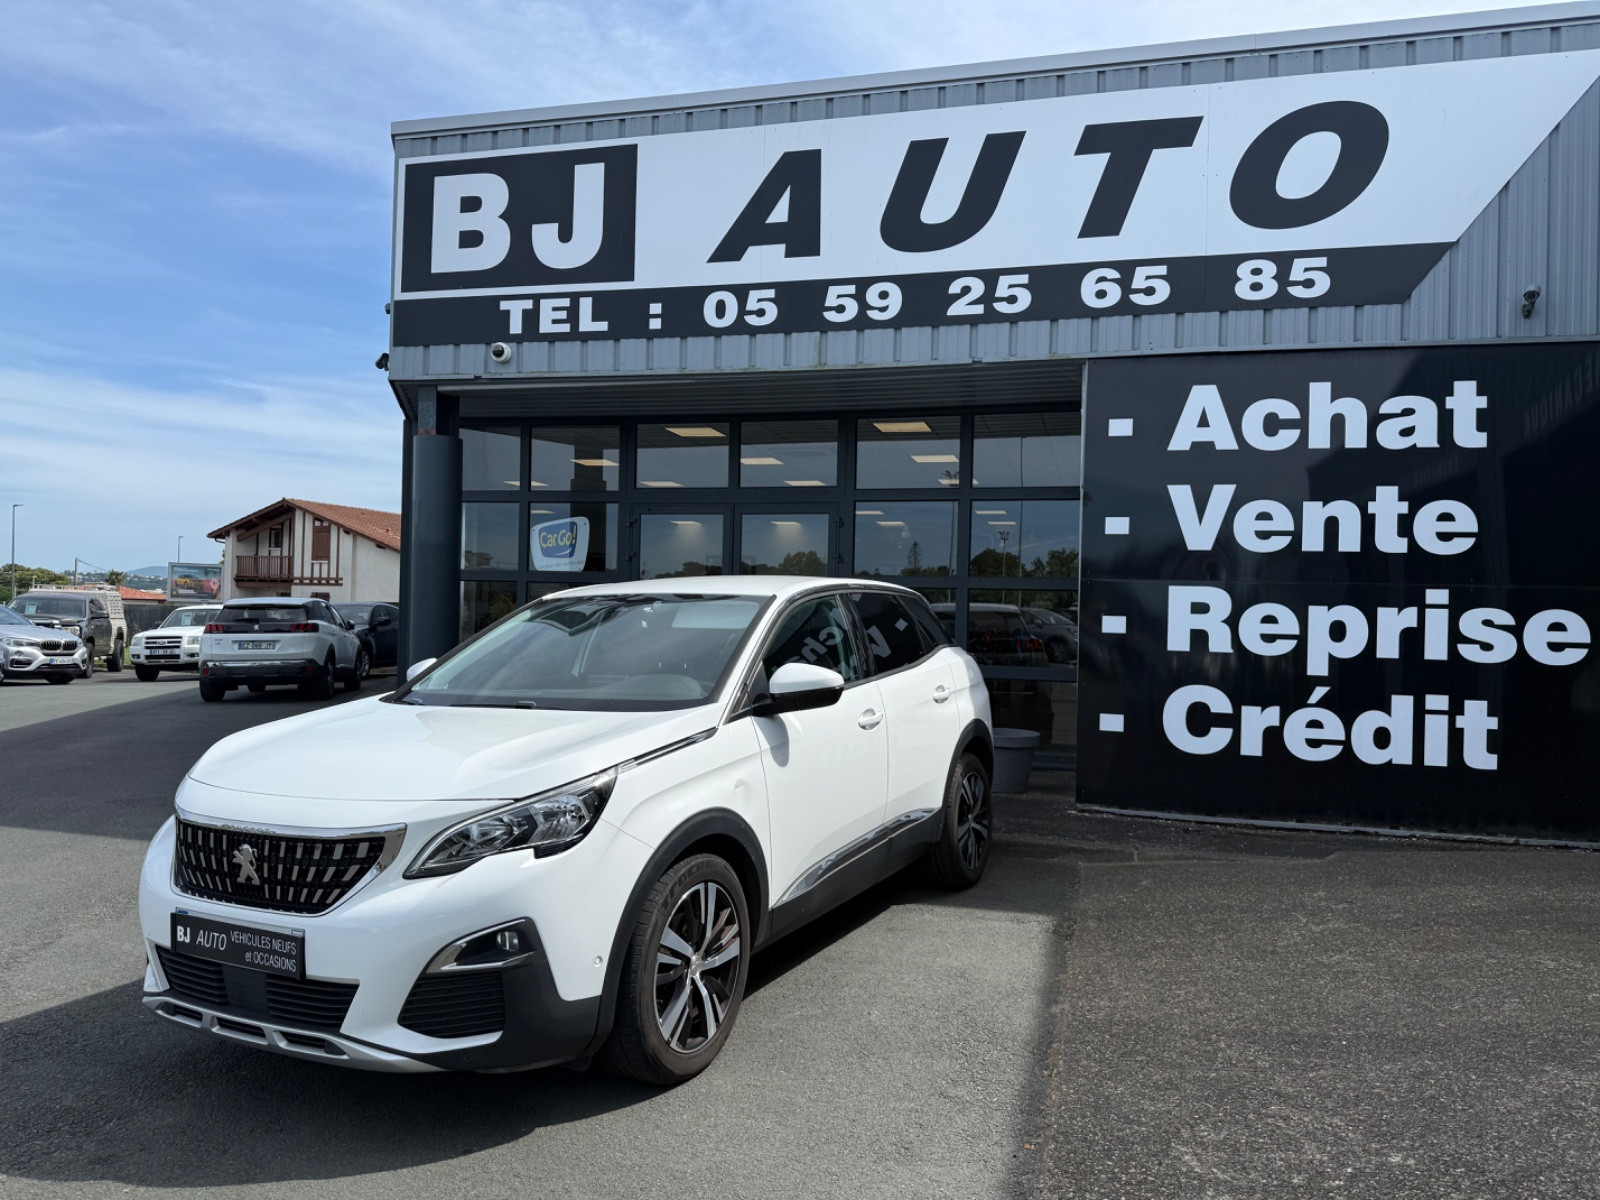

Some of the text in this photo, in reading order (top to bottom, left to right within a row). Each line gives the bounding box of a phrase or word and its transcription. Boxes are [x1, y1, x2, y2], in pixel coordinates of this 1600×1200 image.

[431, 101, 1389, 274] BJ AUTO
[500, 297, 608, 335] TEL
[704, 289, 778, 328] 05
[823, 282, 902, 322] 59
[947, 274, 1031, 315] 25
[1081, 265, 1170, 308] 65
[1235, 257, 1330, 300] 85
[1167, 381, 1487, 452] Achat
[1167, 484, 1478, 555] Vente
[1167, 586, 1590, 676] Reprise
[1163, 685, 1498, 769] Crédit
[177, 926, 227, 950] BJ AUTO
[230, 930, 297, 955] VEHICULES NEUFS
[244, 952, 297, 972] et OCCASIONS
